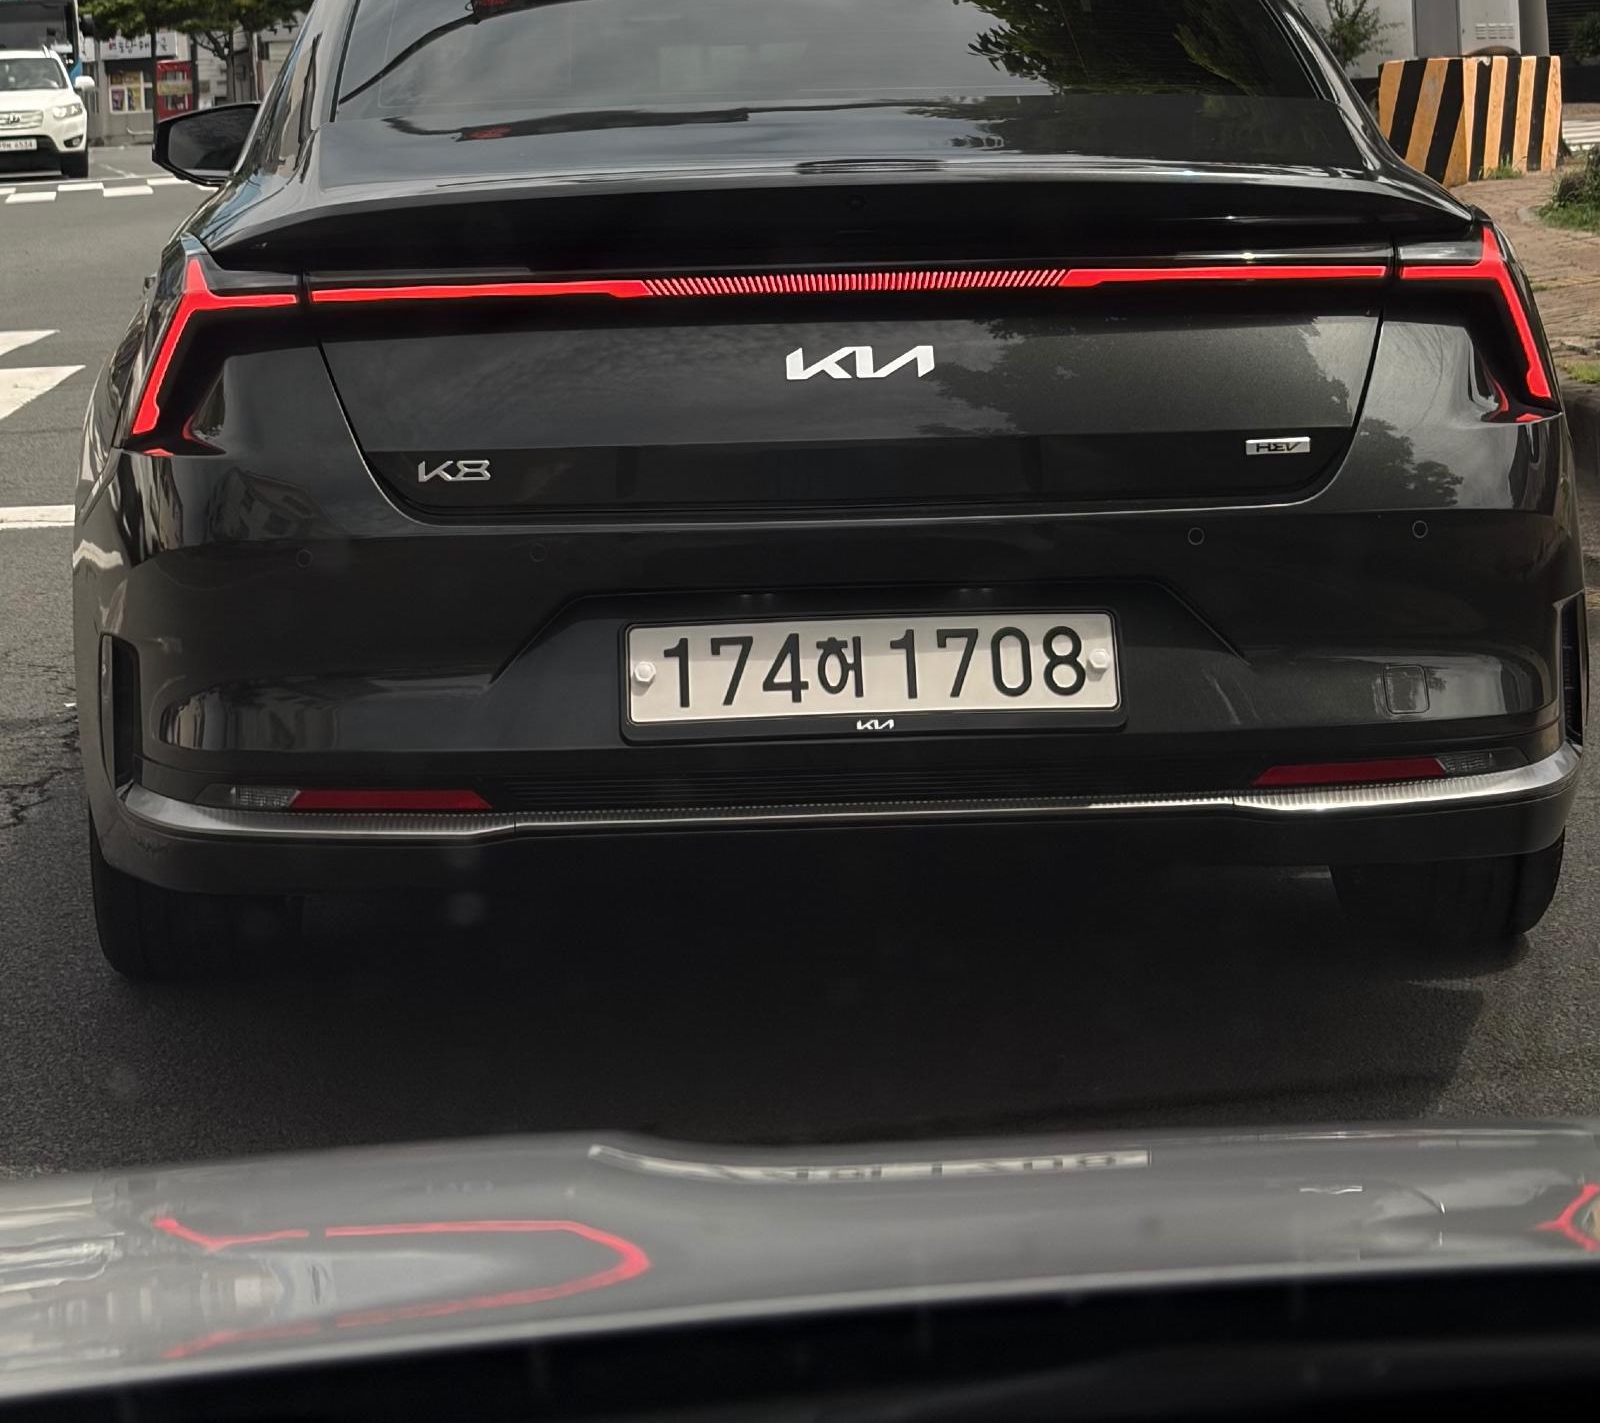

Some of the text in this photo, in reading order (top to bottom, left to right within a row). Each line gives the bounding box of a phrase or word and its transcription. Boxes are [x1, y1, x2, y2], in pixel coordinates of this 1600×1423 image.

[785, 345, 935, 380] KIA
[1256, 441, 1301, 453] HEV
[418, 460, 491, 482] K8
[663, 625, 1086, 707] 174허 1708
[856, 719, 894, 730] KIA
